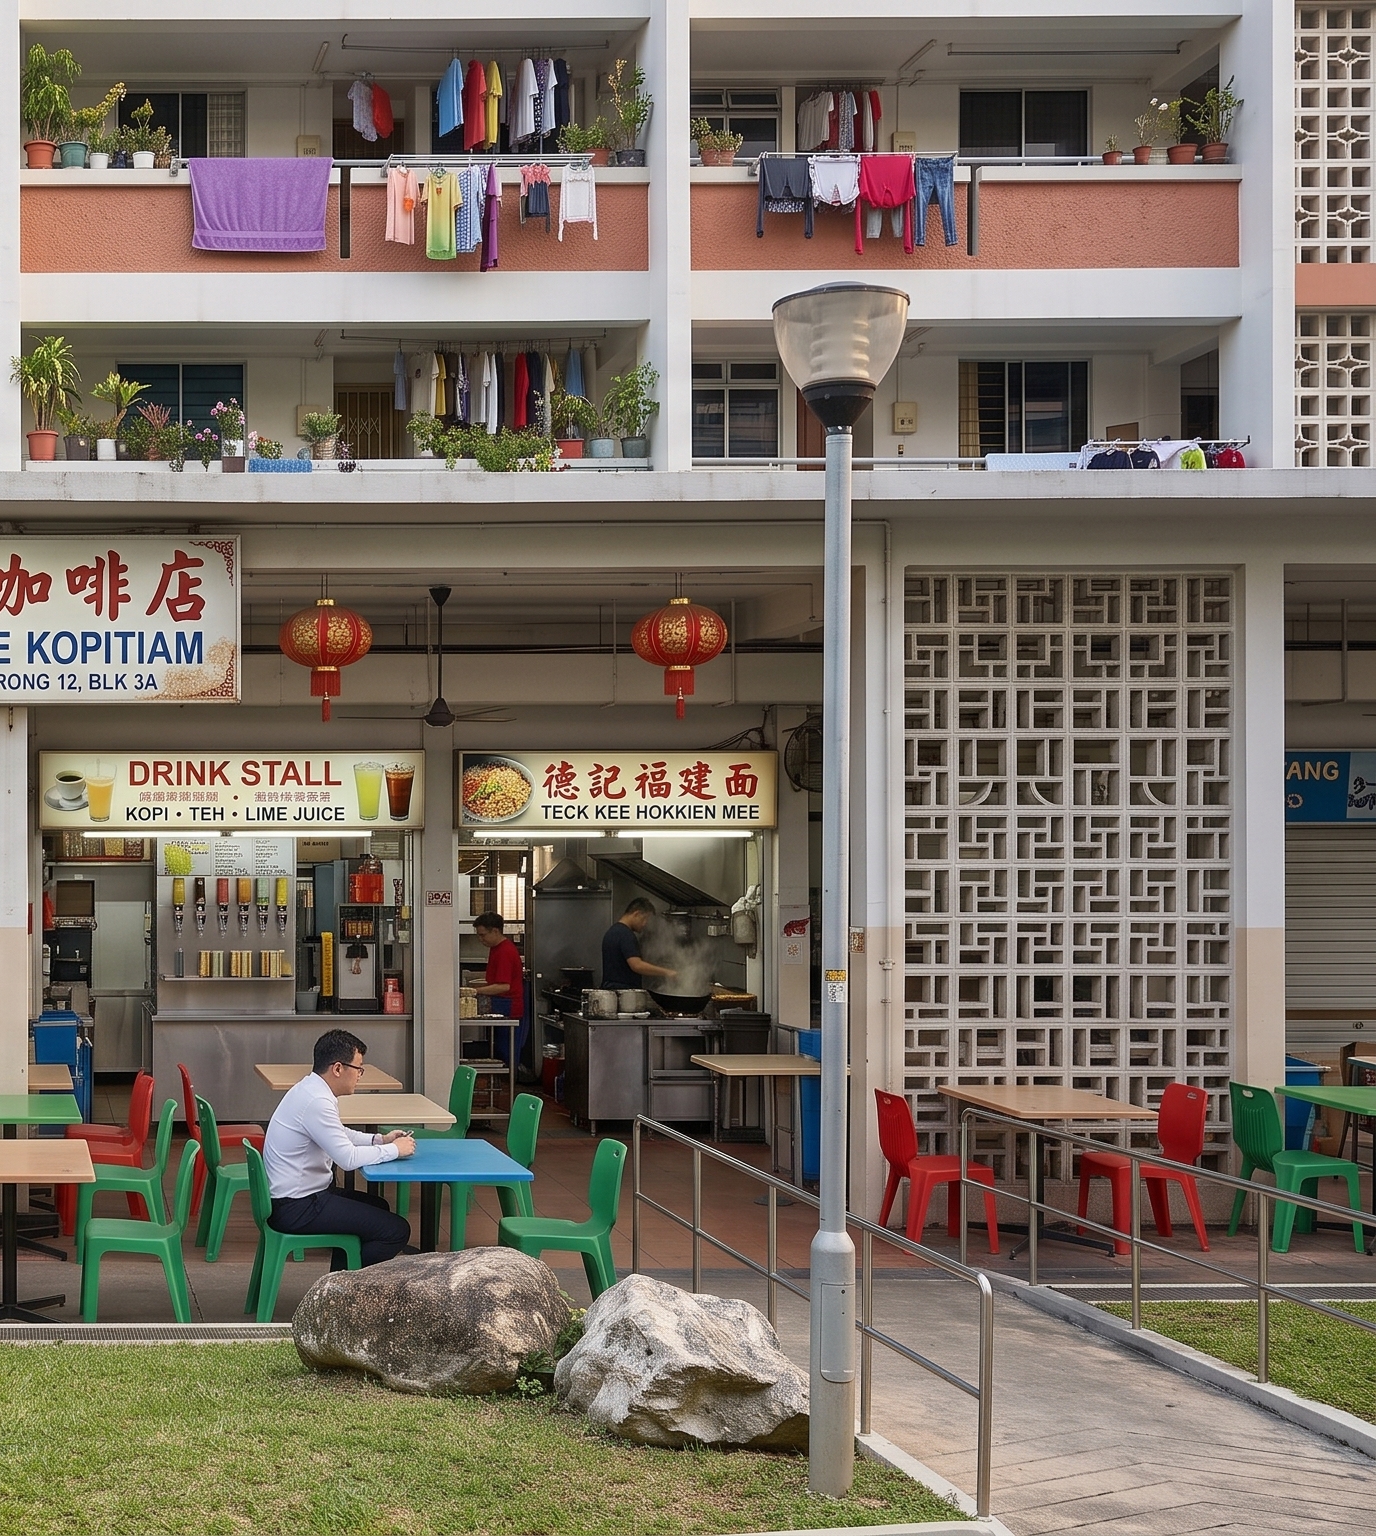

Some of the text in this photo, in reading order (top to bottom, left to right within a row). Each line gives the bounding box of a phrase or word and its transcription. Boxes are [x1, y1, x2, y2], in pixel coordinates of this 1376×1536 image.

[27, 631, 203, 665] KOPITIAM
[57, 673, 82, 693] 12,
[89, 673, 128, 690] BLK
[134, 673, 158, 691] 3A
[129, 760, 342, 787] DRINK STALL
[542, 760, 759, 801] 德記福建面
[1284, 761, 1340, 781] ANG
[125, 806, 345, 821] KOPI TEH LIME JUICE
[541, 805, 760, 820] TECK KEE HOKKIEN MEE
